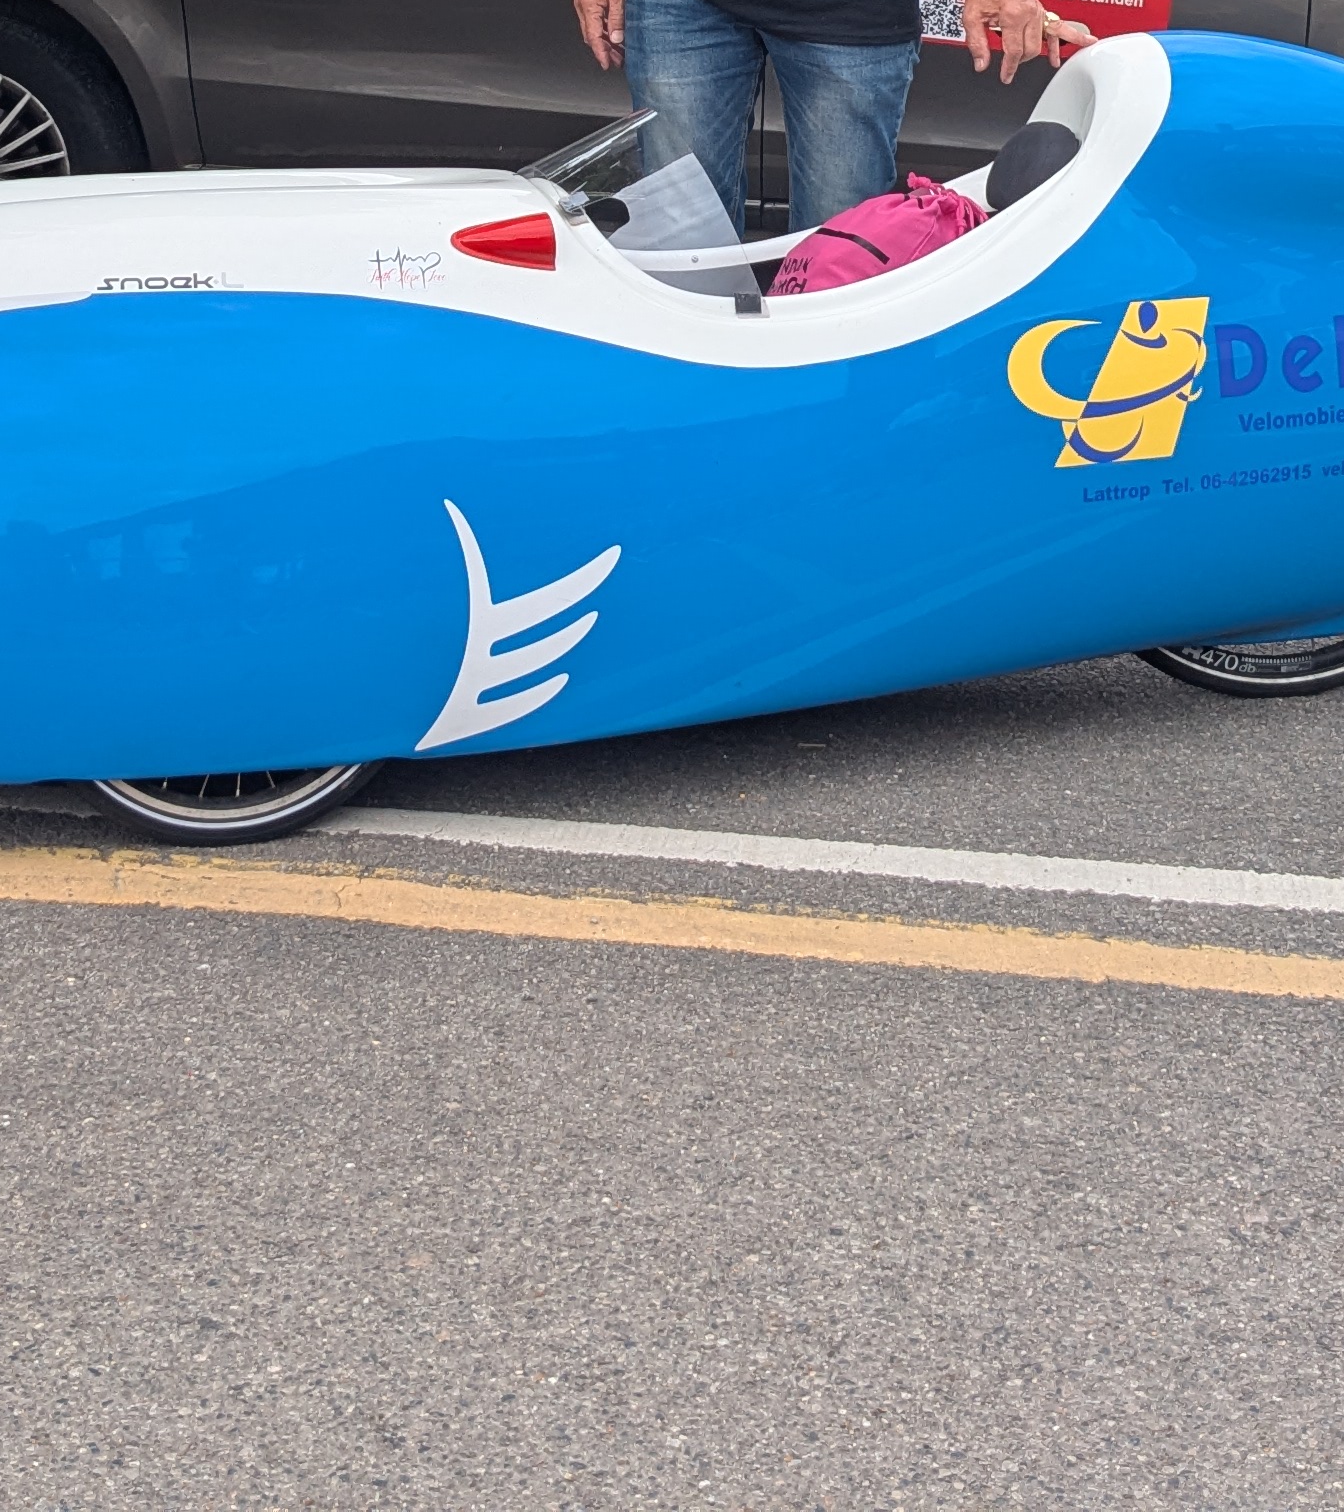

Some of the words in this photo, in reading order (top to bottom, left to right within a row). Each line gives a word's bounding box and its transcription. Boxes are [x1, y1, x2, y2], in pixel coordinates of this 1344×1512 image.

[1082, 484, 1151, 502] Lattrop
[1162, 477, 1195, 495] Tel.
[1200, 463, 1312, 490] 06-42962915
